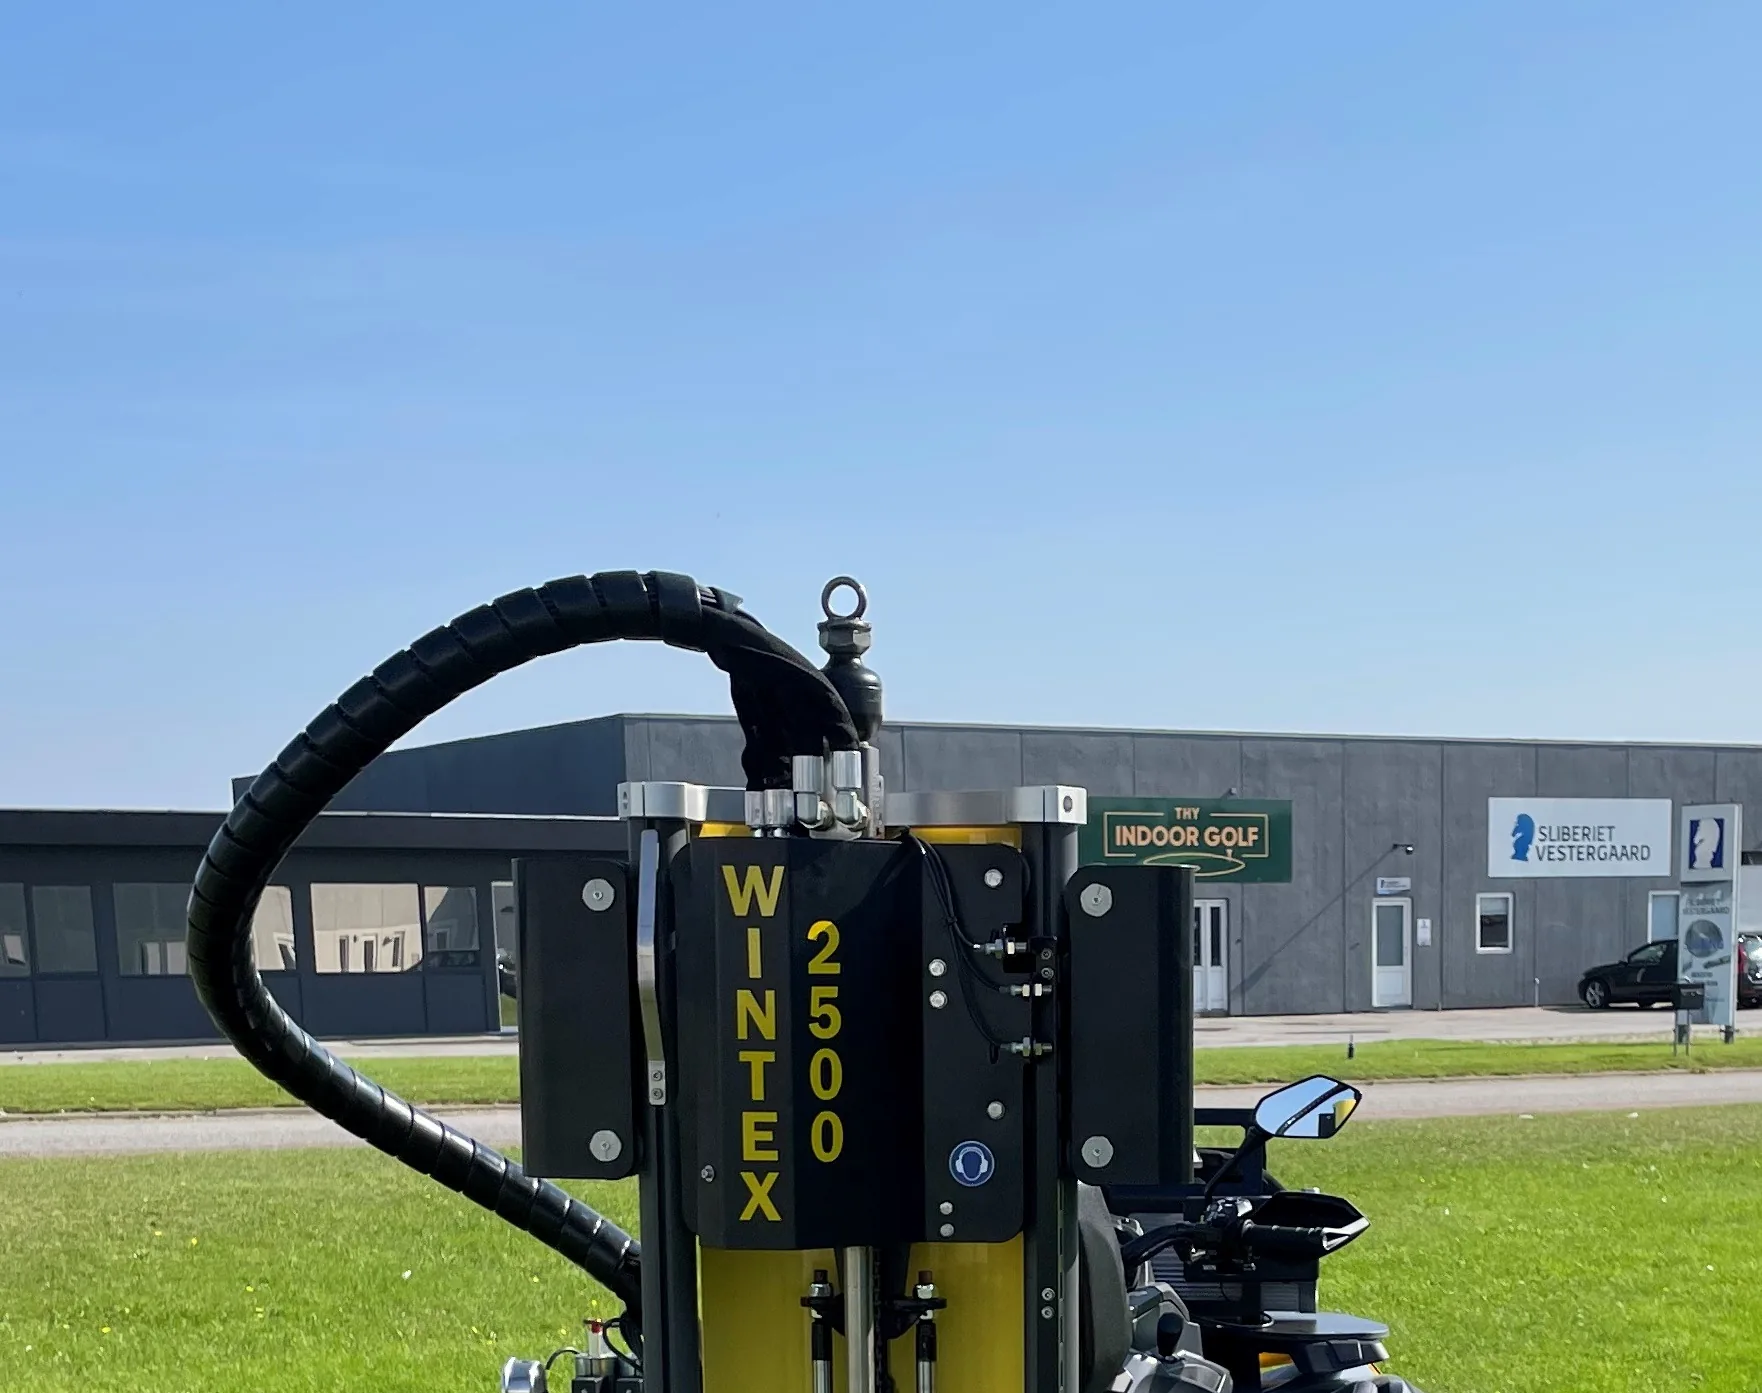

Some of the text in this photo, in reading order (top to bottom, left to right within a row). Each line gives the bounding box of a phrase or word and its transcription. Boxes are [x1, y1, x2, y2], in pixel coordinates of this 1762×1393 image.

[1174, 807, 1200, 820] THY
[1115, 825, 1259, 847] INDOOR GOLF
[1537, 825, 1615, 842] SLIBERIET
[1534, 844, 1651, 862] VESTERGAARD
[721, 864, 785, 1221] WINTEX
[807, 920, 844, 1163] 2500
